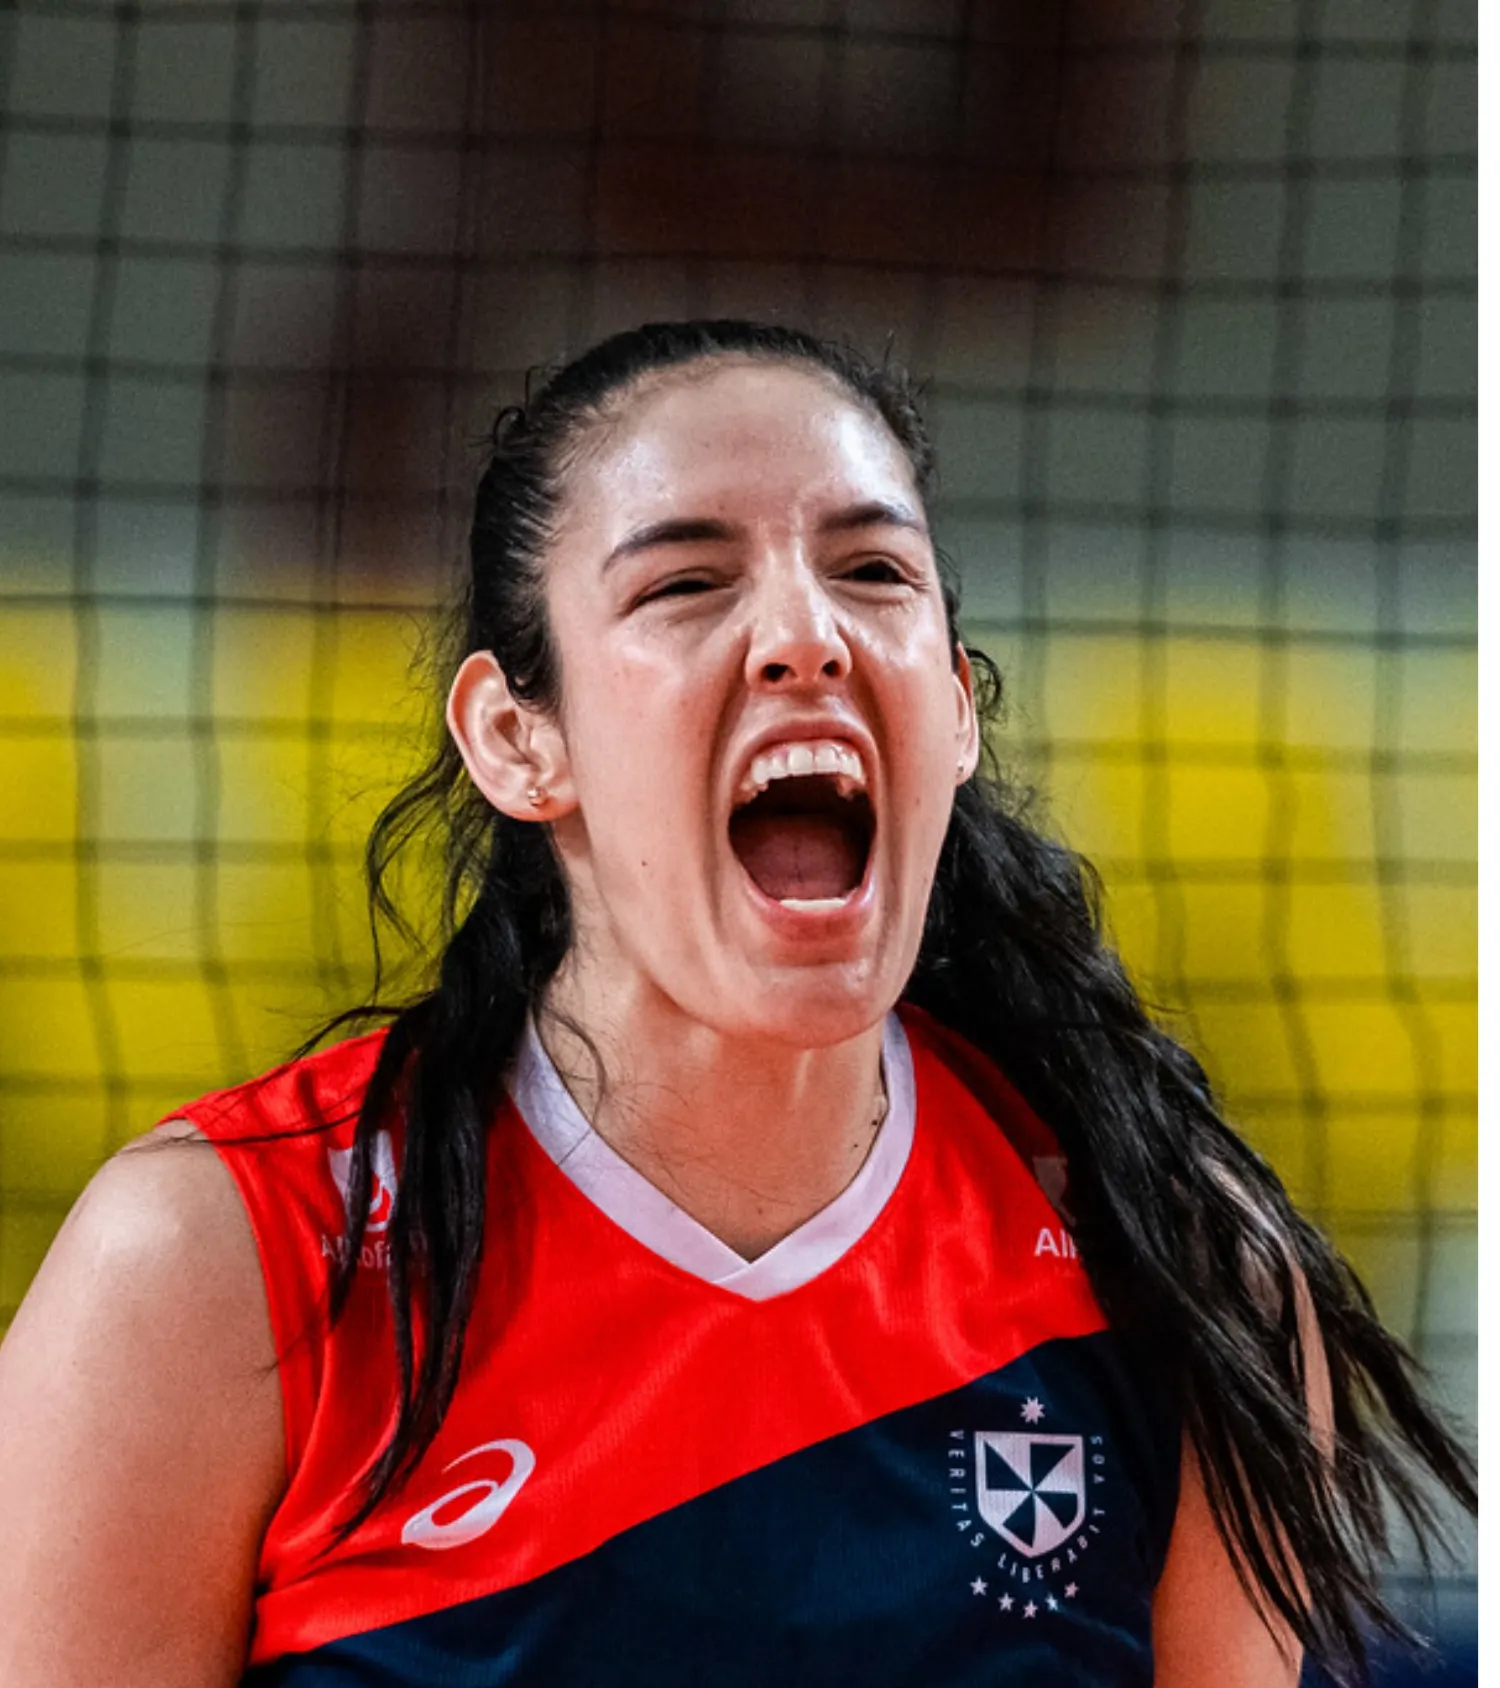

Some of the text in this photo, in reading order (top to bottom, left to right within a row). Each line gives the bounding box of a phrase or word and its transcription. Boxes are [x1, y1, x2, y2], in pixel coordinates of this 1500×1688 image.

[948, 1429, 1106, 1584] VERITAS LIBERABIT VOS
